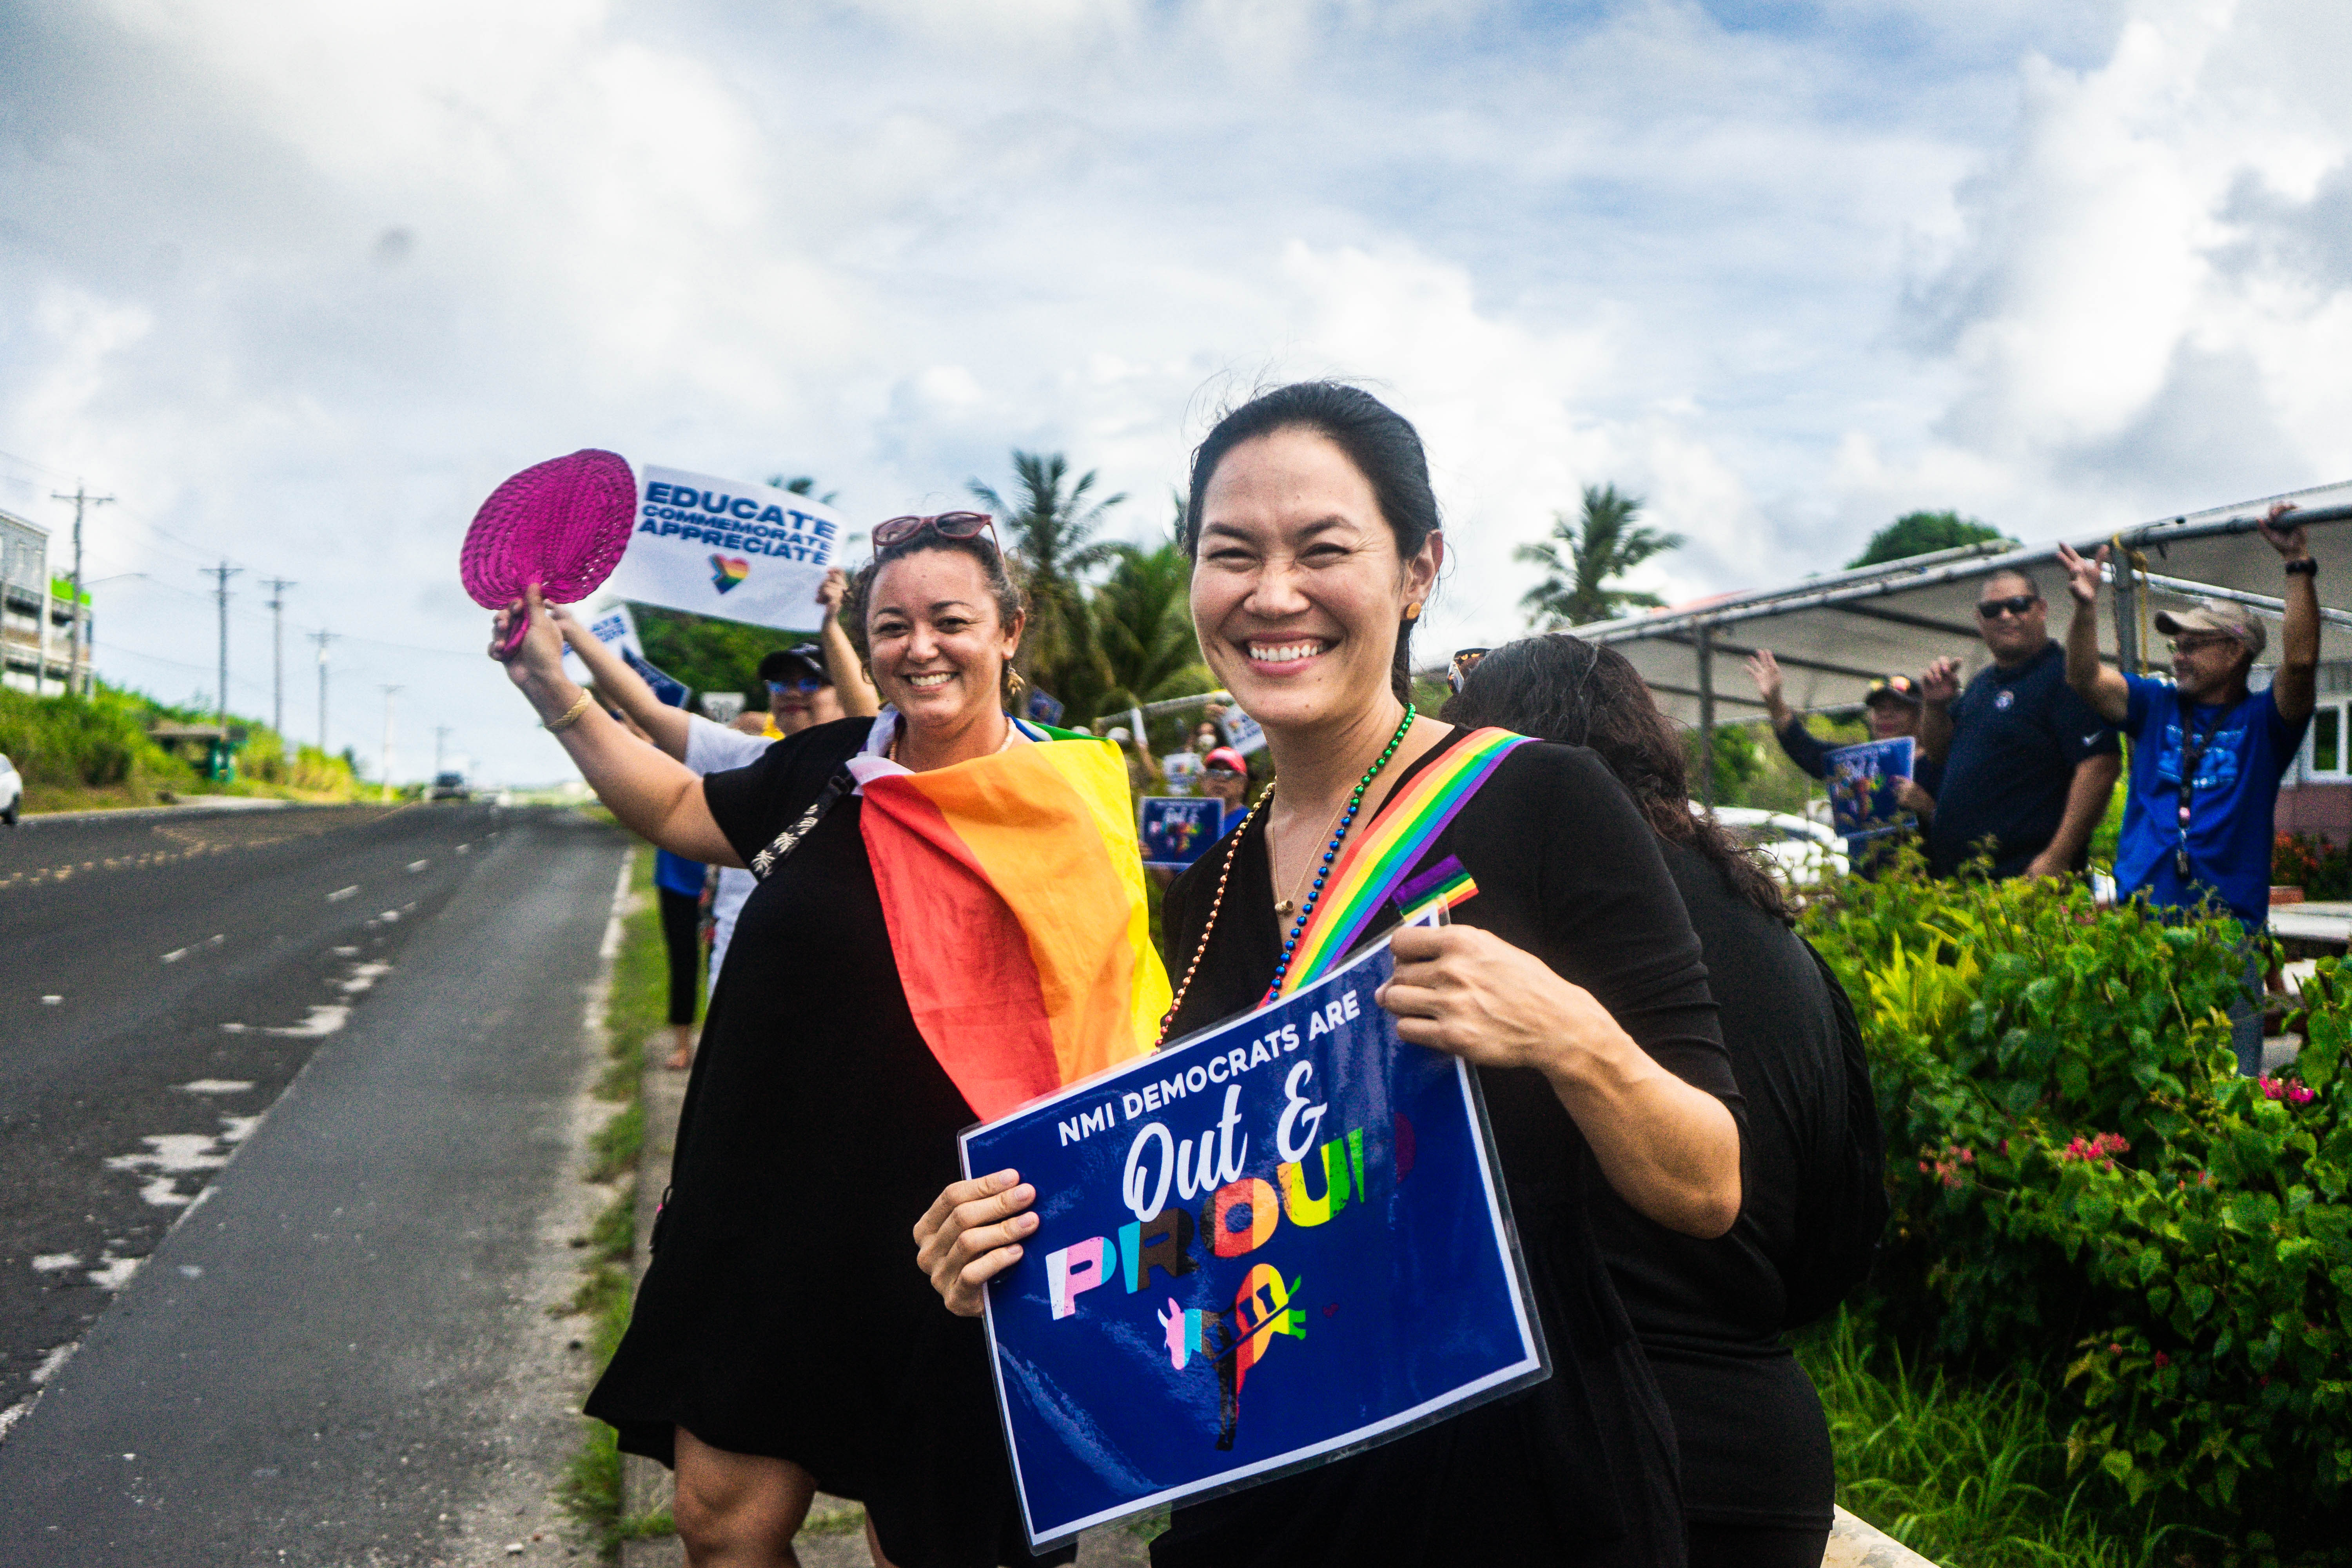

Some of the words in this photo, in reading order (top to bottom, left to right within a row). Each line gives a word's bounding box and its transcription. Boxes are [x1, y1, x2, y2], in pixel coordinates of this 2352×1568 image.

[642, 504, 834, 553] COMMEMORATE
[646, 481, 839, 541] EDUCATE
[638, 517, 831, 566] APPRECIATE
[1058, 1102, 1115, 1147] NMI
[1122, 1024, 1300, 1120] DEMOCRATS
[1308, 989, 1361, 1042] ARE
[1123, 1084, 1248, 1223] Out
[1276, 1059, 1328, 1164] &
